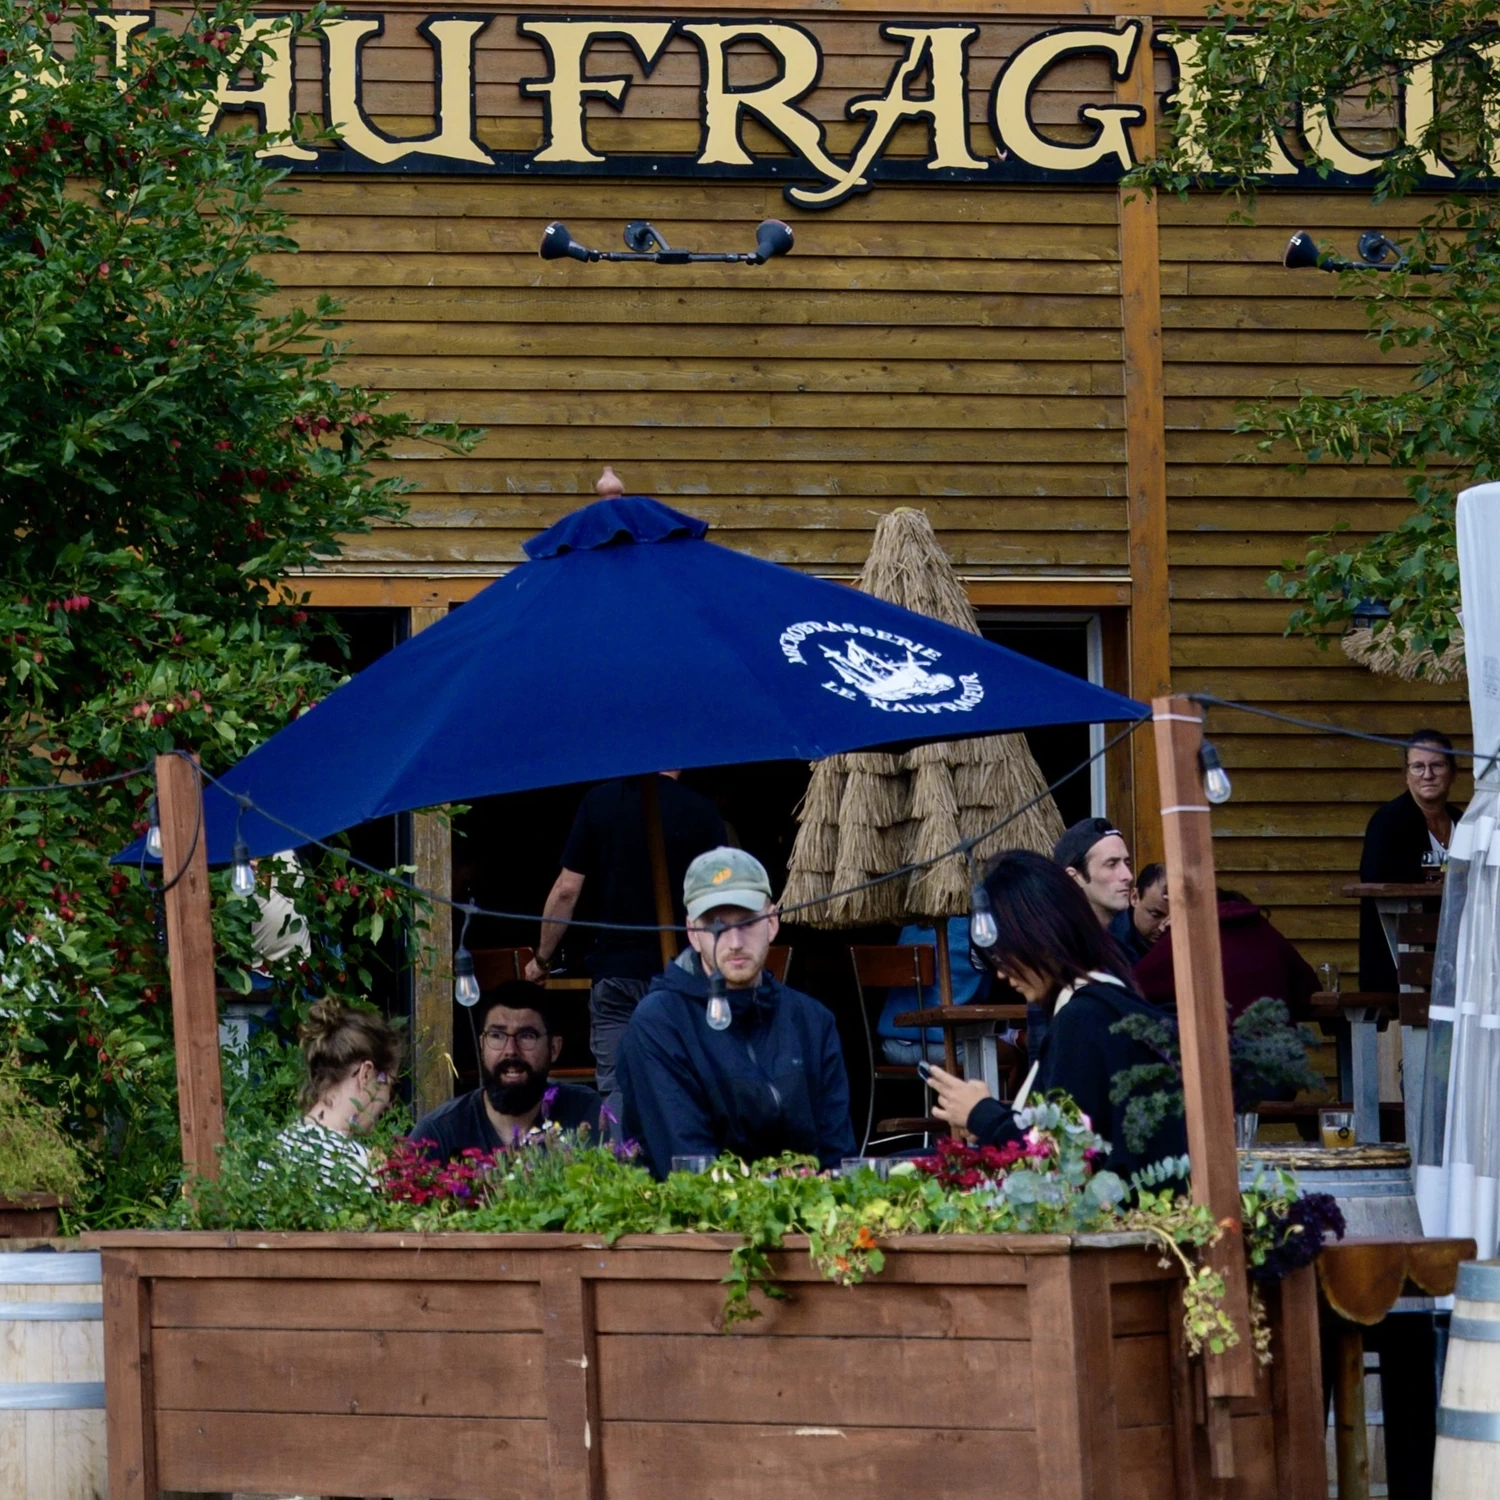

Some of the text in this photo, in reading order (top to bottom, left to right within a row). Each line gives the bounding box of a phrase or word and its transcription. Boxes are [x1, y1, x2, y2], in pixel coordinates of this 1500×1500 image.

[779, 620, 942, 666] MICROBRASSERIE
[821, 672, 984, 714] LE NAUFRAGEUR
